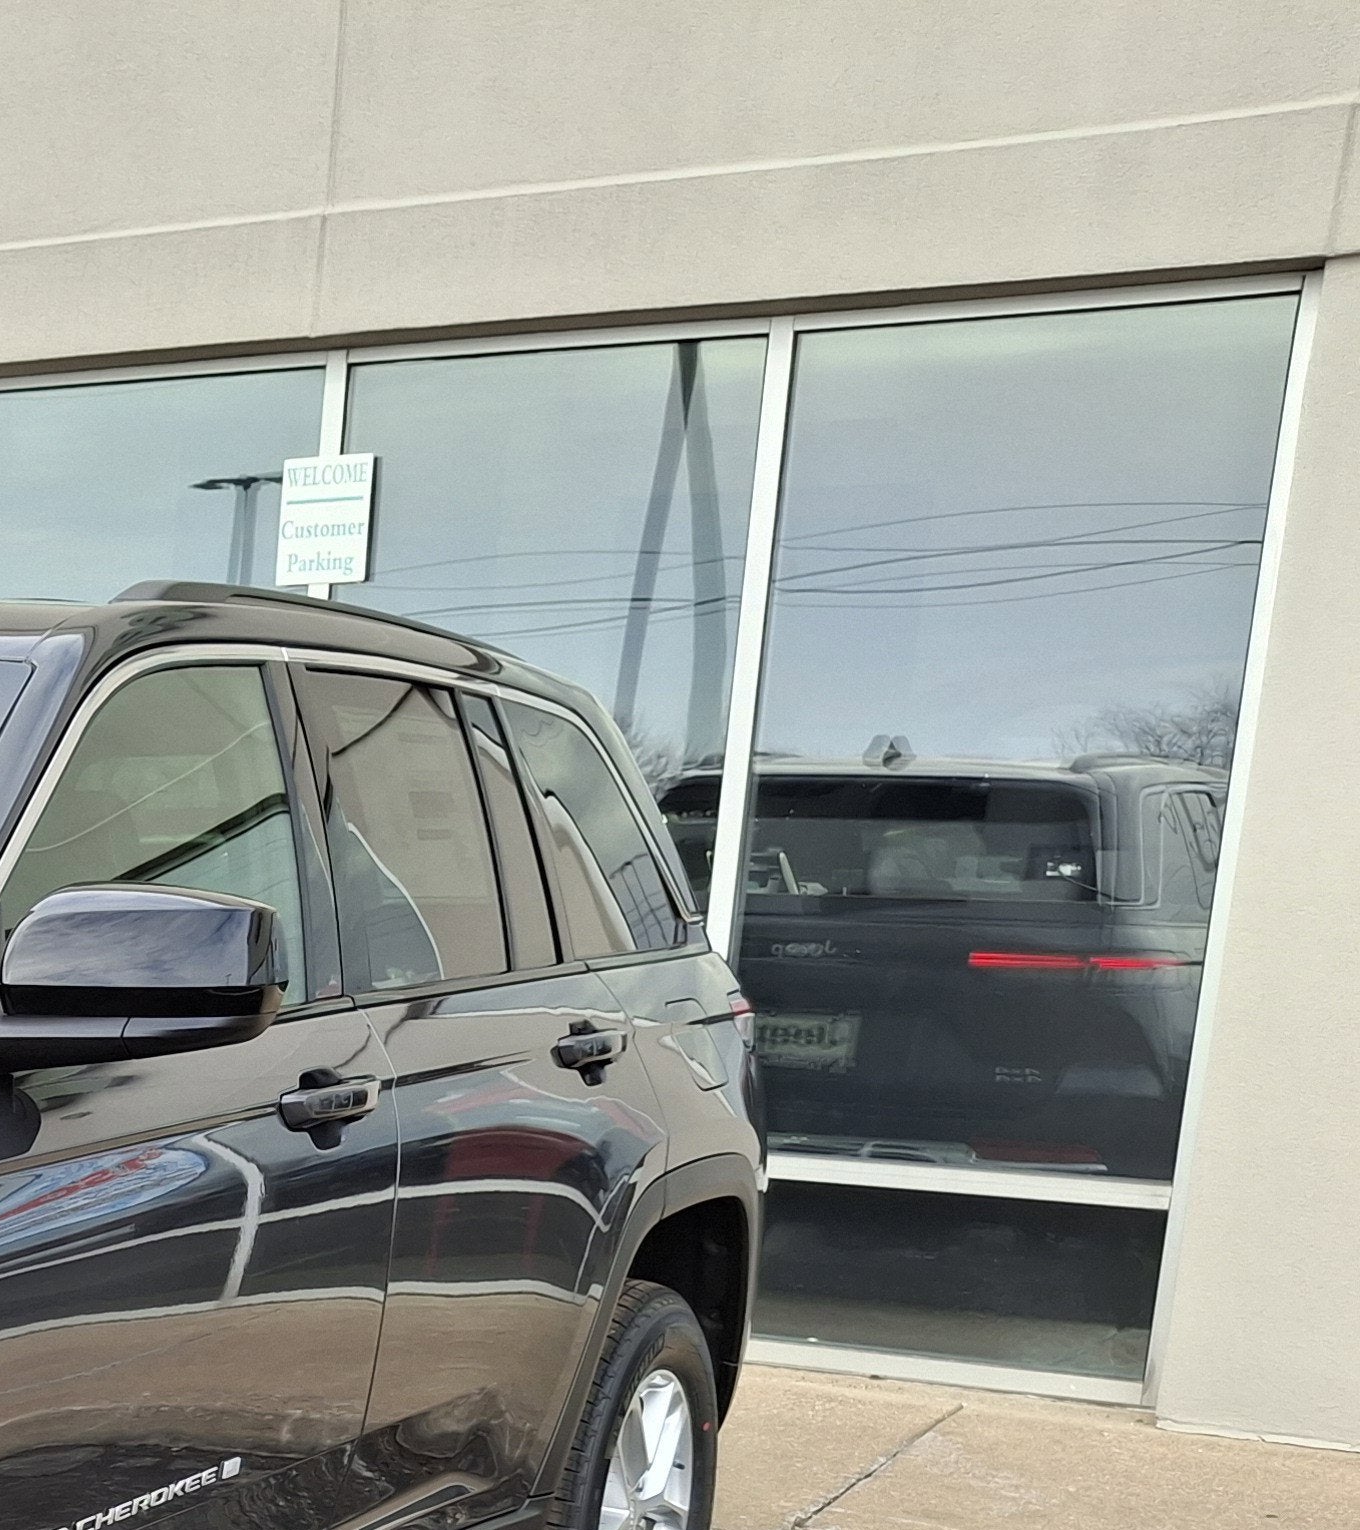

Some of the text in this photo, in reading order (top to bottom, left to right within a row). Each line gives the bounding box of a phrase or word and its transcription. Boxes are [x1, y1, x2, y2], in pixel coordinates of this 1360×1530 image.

[287, 462, 369, 488] WELCOME
[281, 519, 365, 541] Customer
[286, 550, 354, 576] Parking
